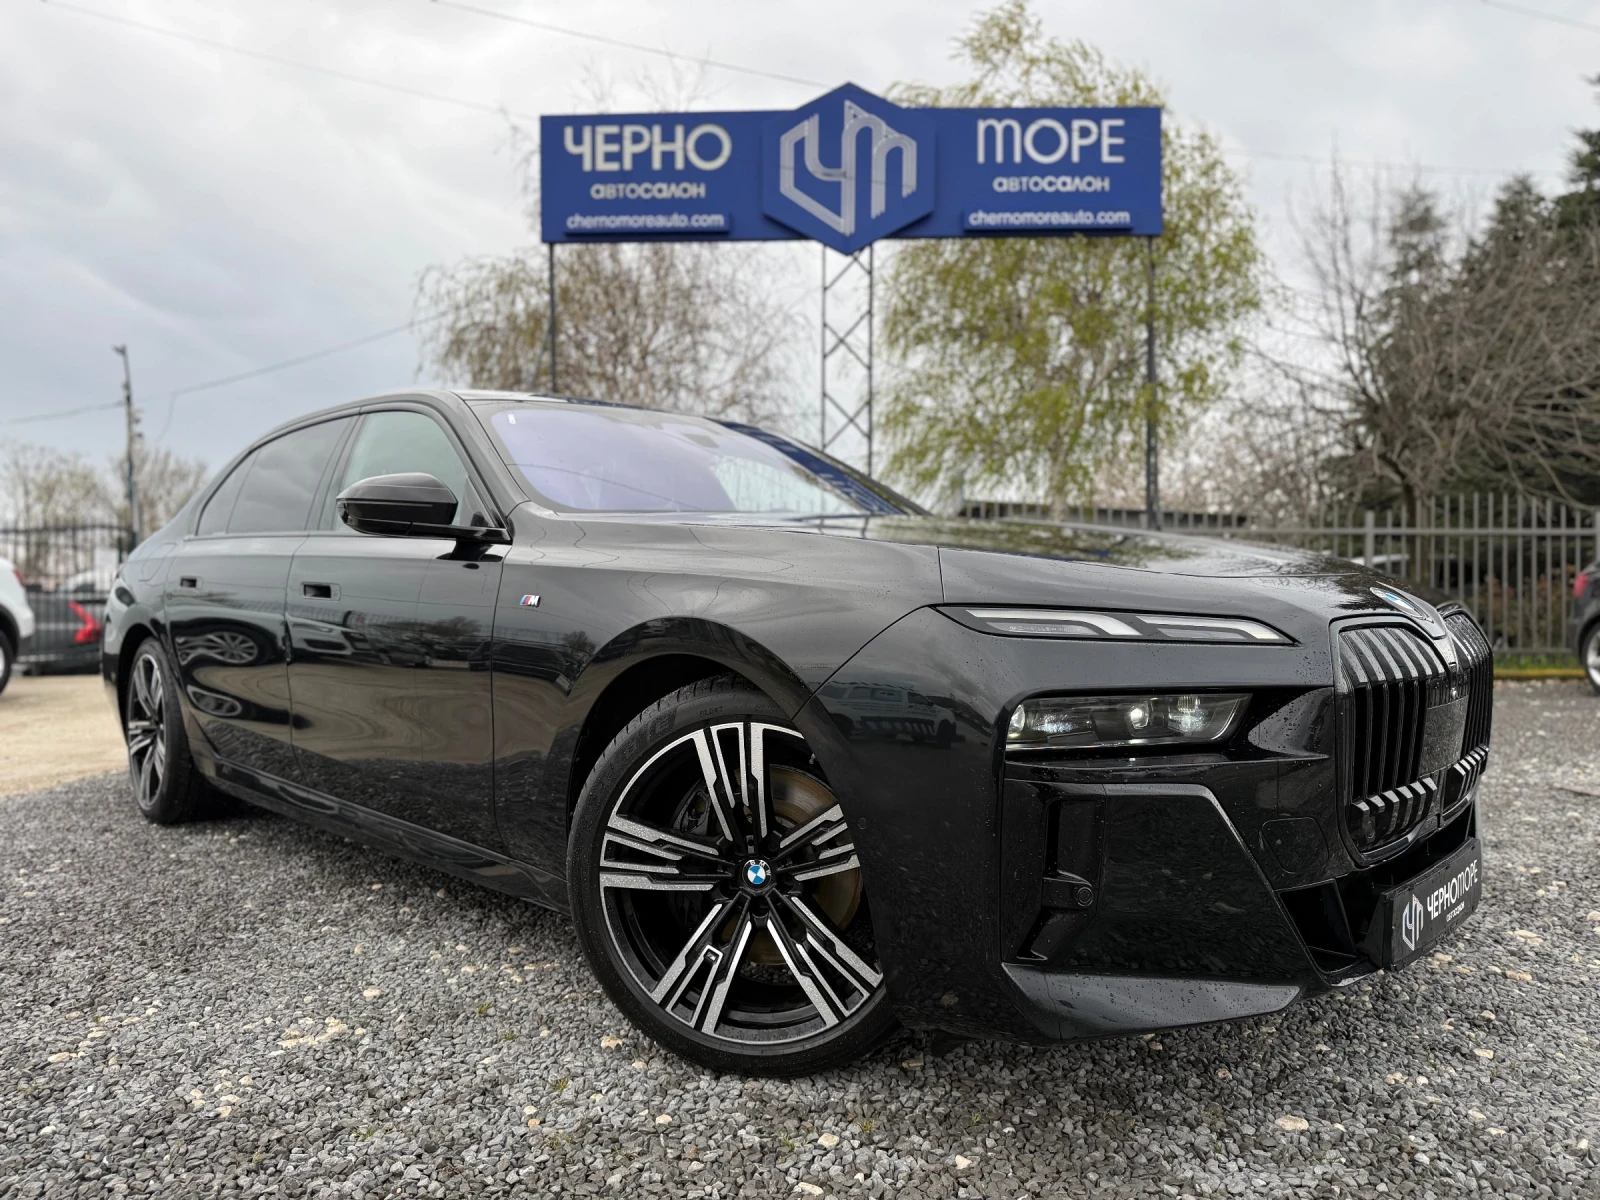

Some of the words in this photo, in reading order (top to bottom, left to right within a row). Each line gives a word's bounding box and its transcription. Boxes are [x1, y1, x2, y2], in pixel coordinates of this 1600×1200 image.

[564, 123, 732, 171] ЧЕРНО
[976, 118, 1126, 165] МОРЕ
[589, 181, 706, 200] автосалон
[992, 175, 1110, 193] автосалон
[566, 211, 725, 230] chernomoreauto.com
[968, 209, 1130, 227] chernomoreauto.com
[1426, 859, 1478, 921] ЧЕРНОМОРЕ
